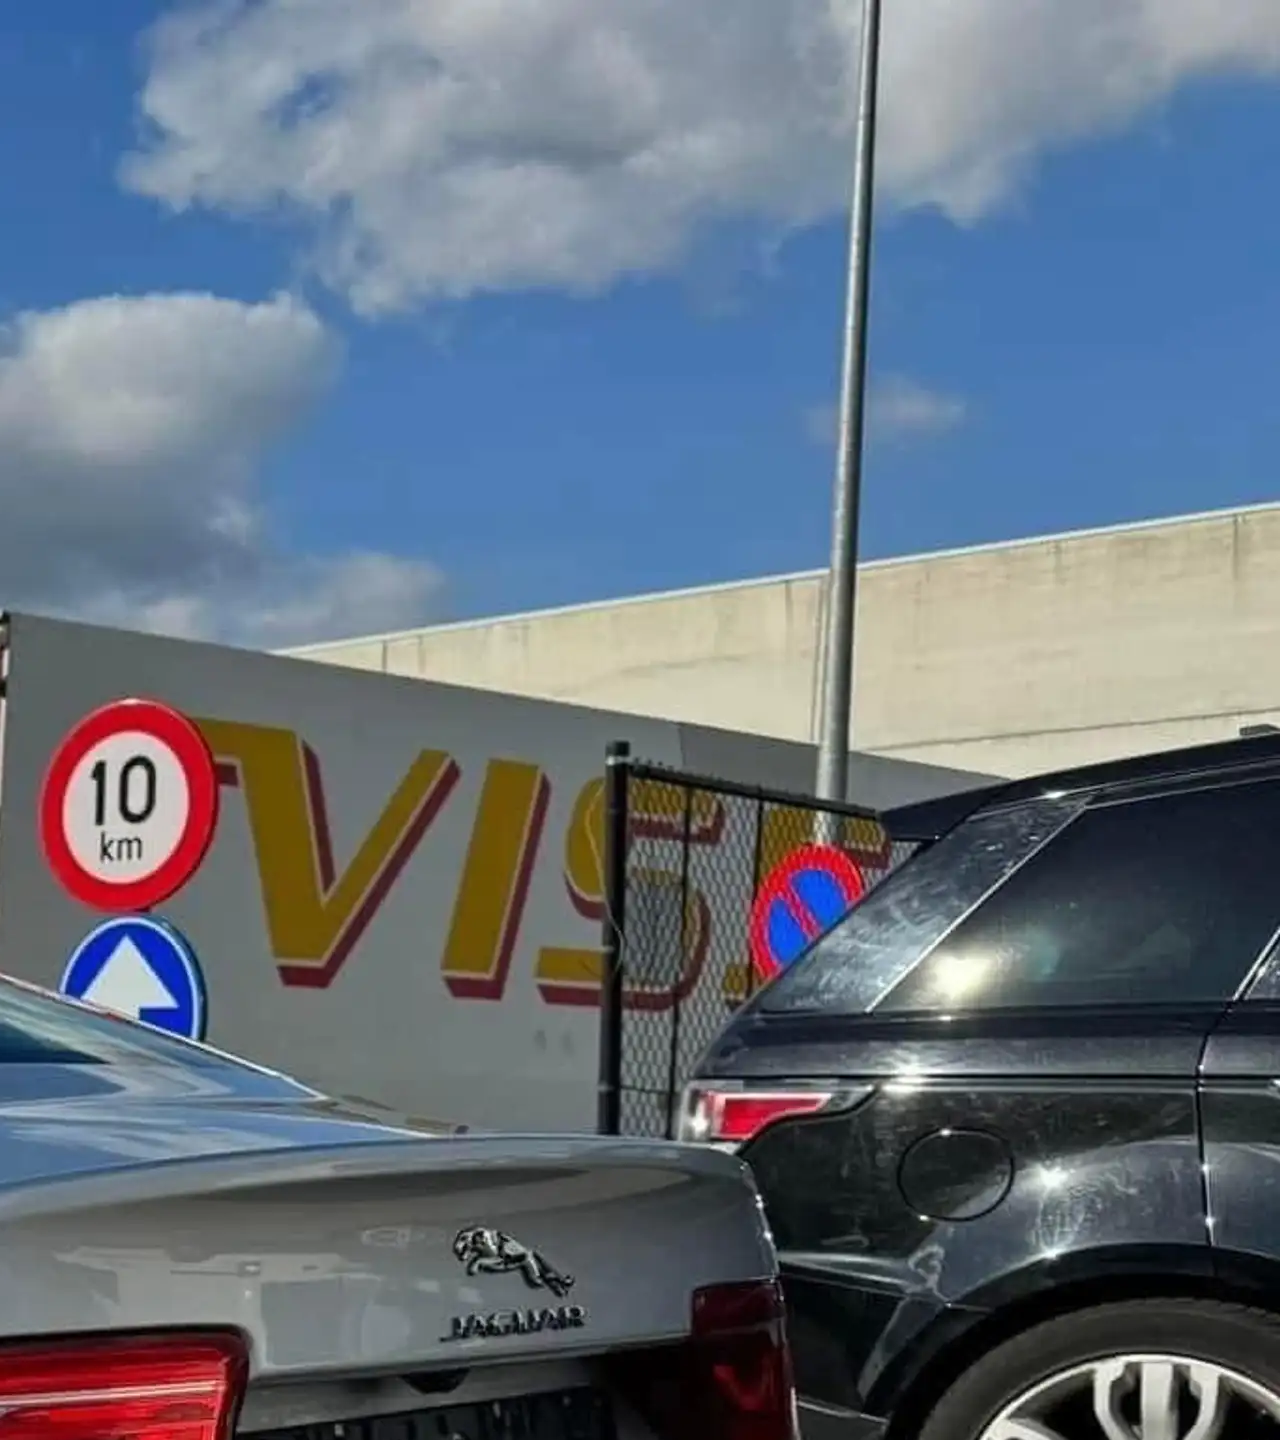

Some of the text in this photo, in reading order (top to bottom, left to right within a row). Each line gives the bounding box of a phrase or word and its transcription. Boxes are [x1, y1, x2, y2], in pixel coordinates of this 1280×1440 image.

[91, 755, 156, 826] 10
[100, 831, 142, 861] km
[439, 1305, 587, 1343] JAGUAR
